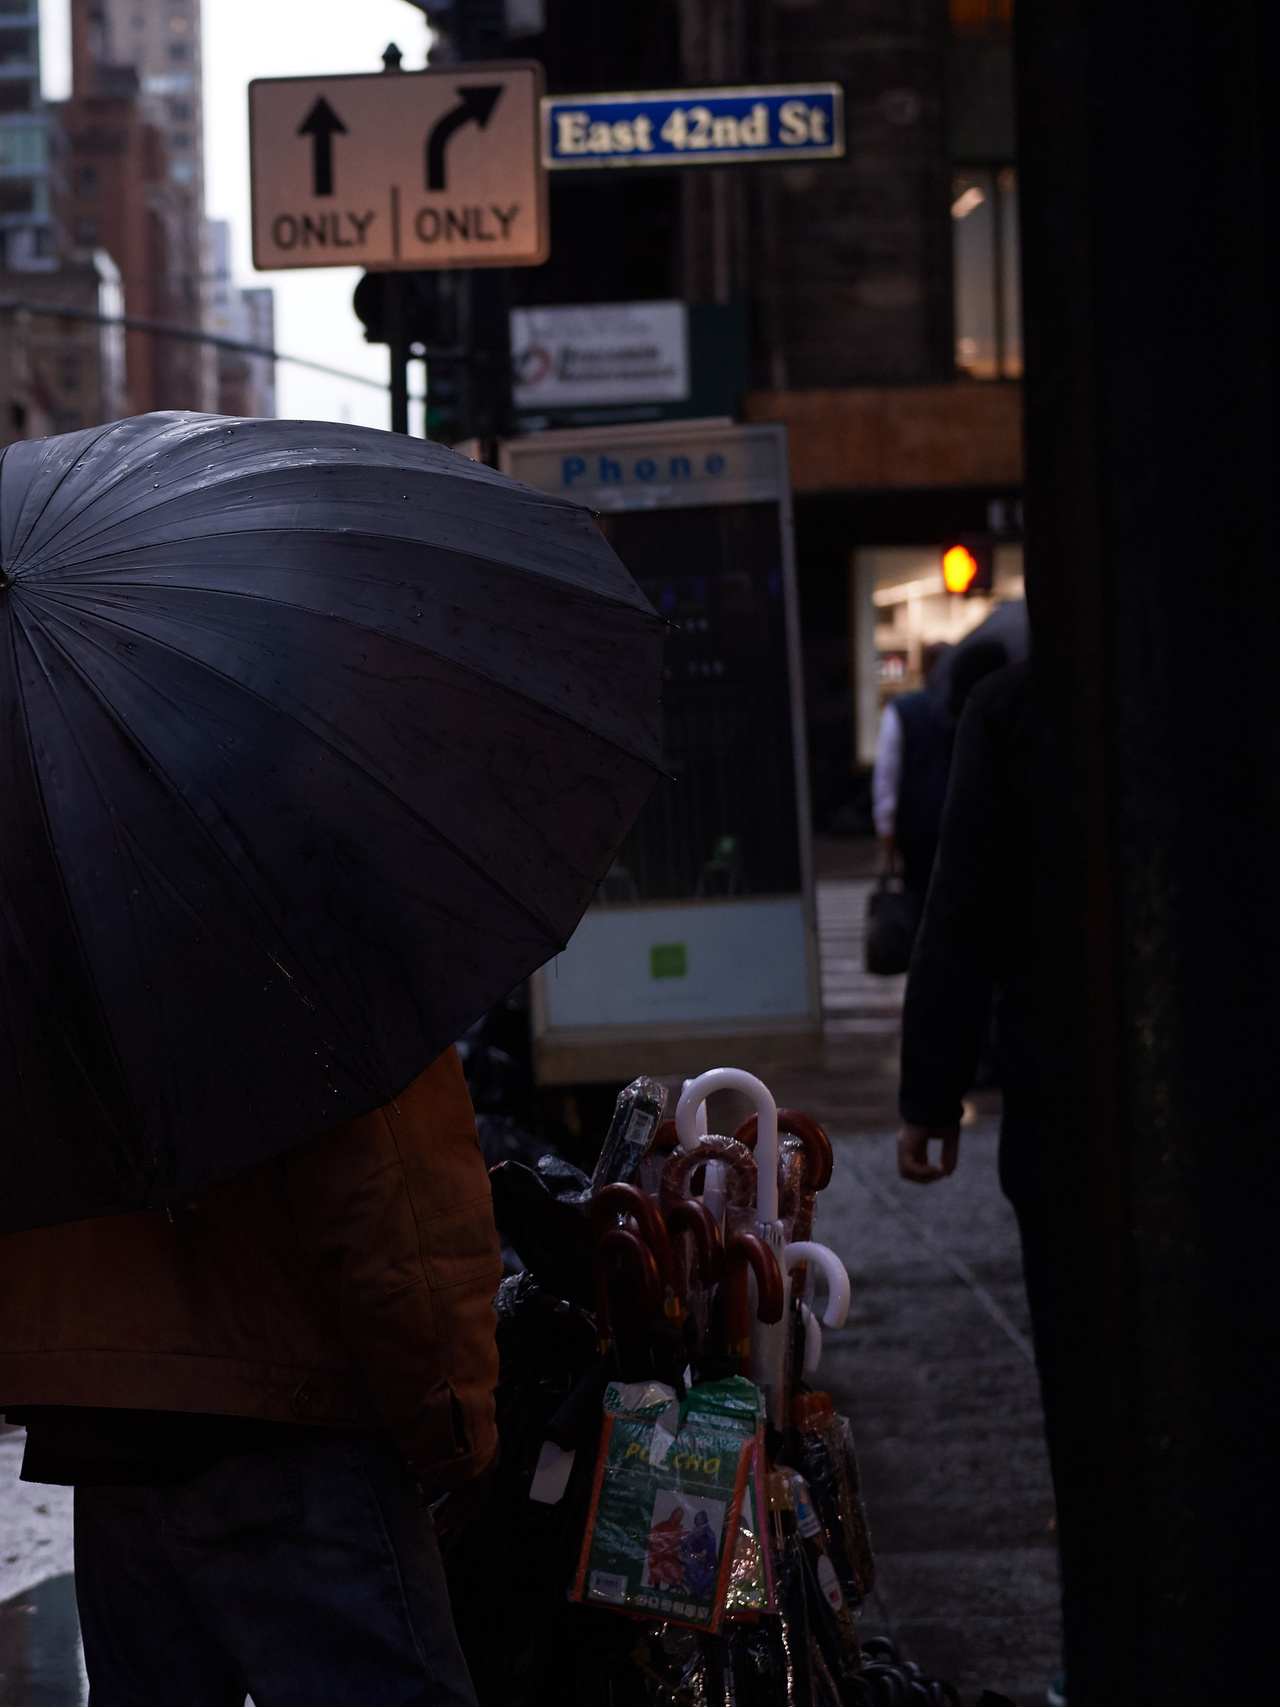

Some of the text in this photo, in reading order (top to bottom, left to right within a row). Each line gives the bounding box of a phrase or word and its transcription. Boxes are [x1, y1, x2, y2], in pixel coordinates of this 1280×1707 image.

[555, 99, 830, 154] East 42nd St
[273, 212, 374, 250] ONLY
[414, 205, 518, 244] ONLY
[562, 454, 726, 486] Phone
[624, 1442, 721, 1475] POCHO
